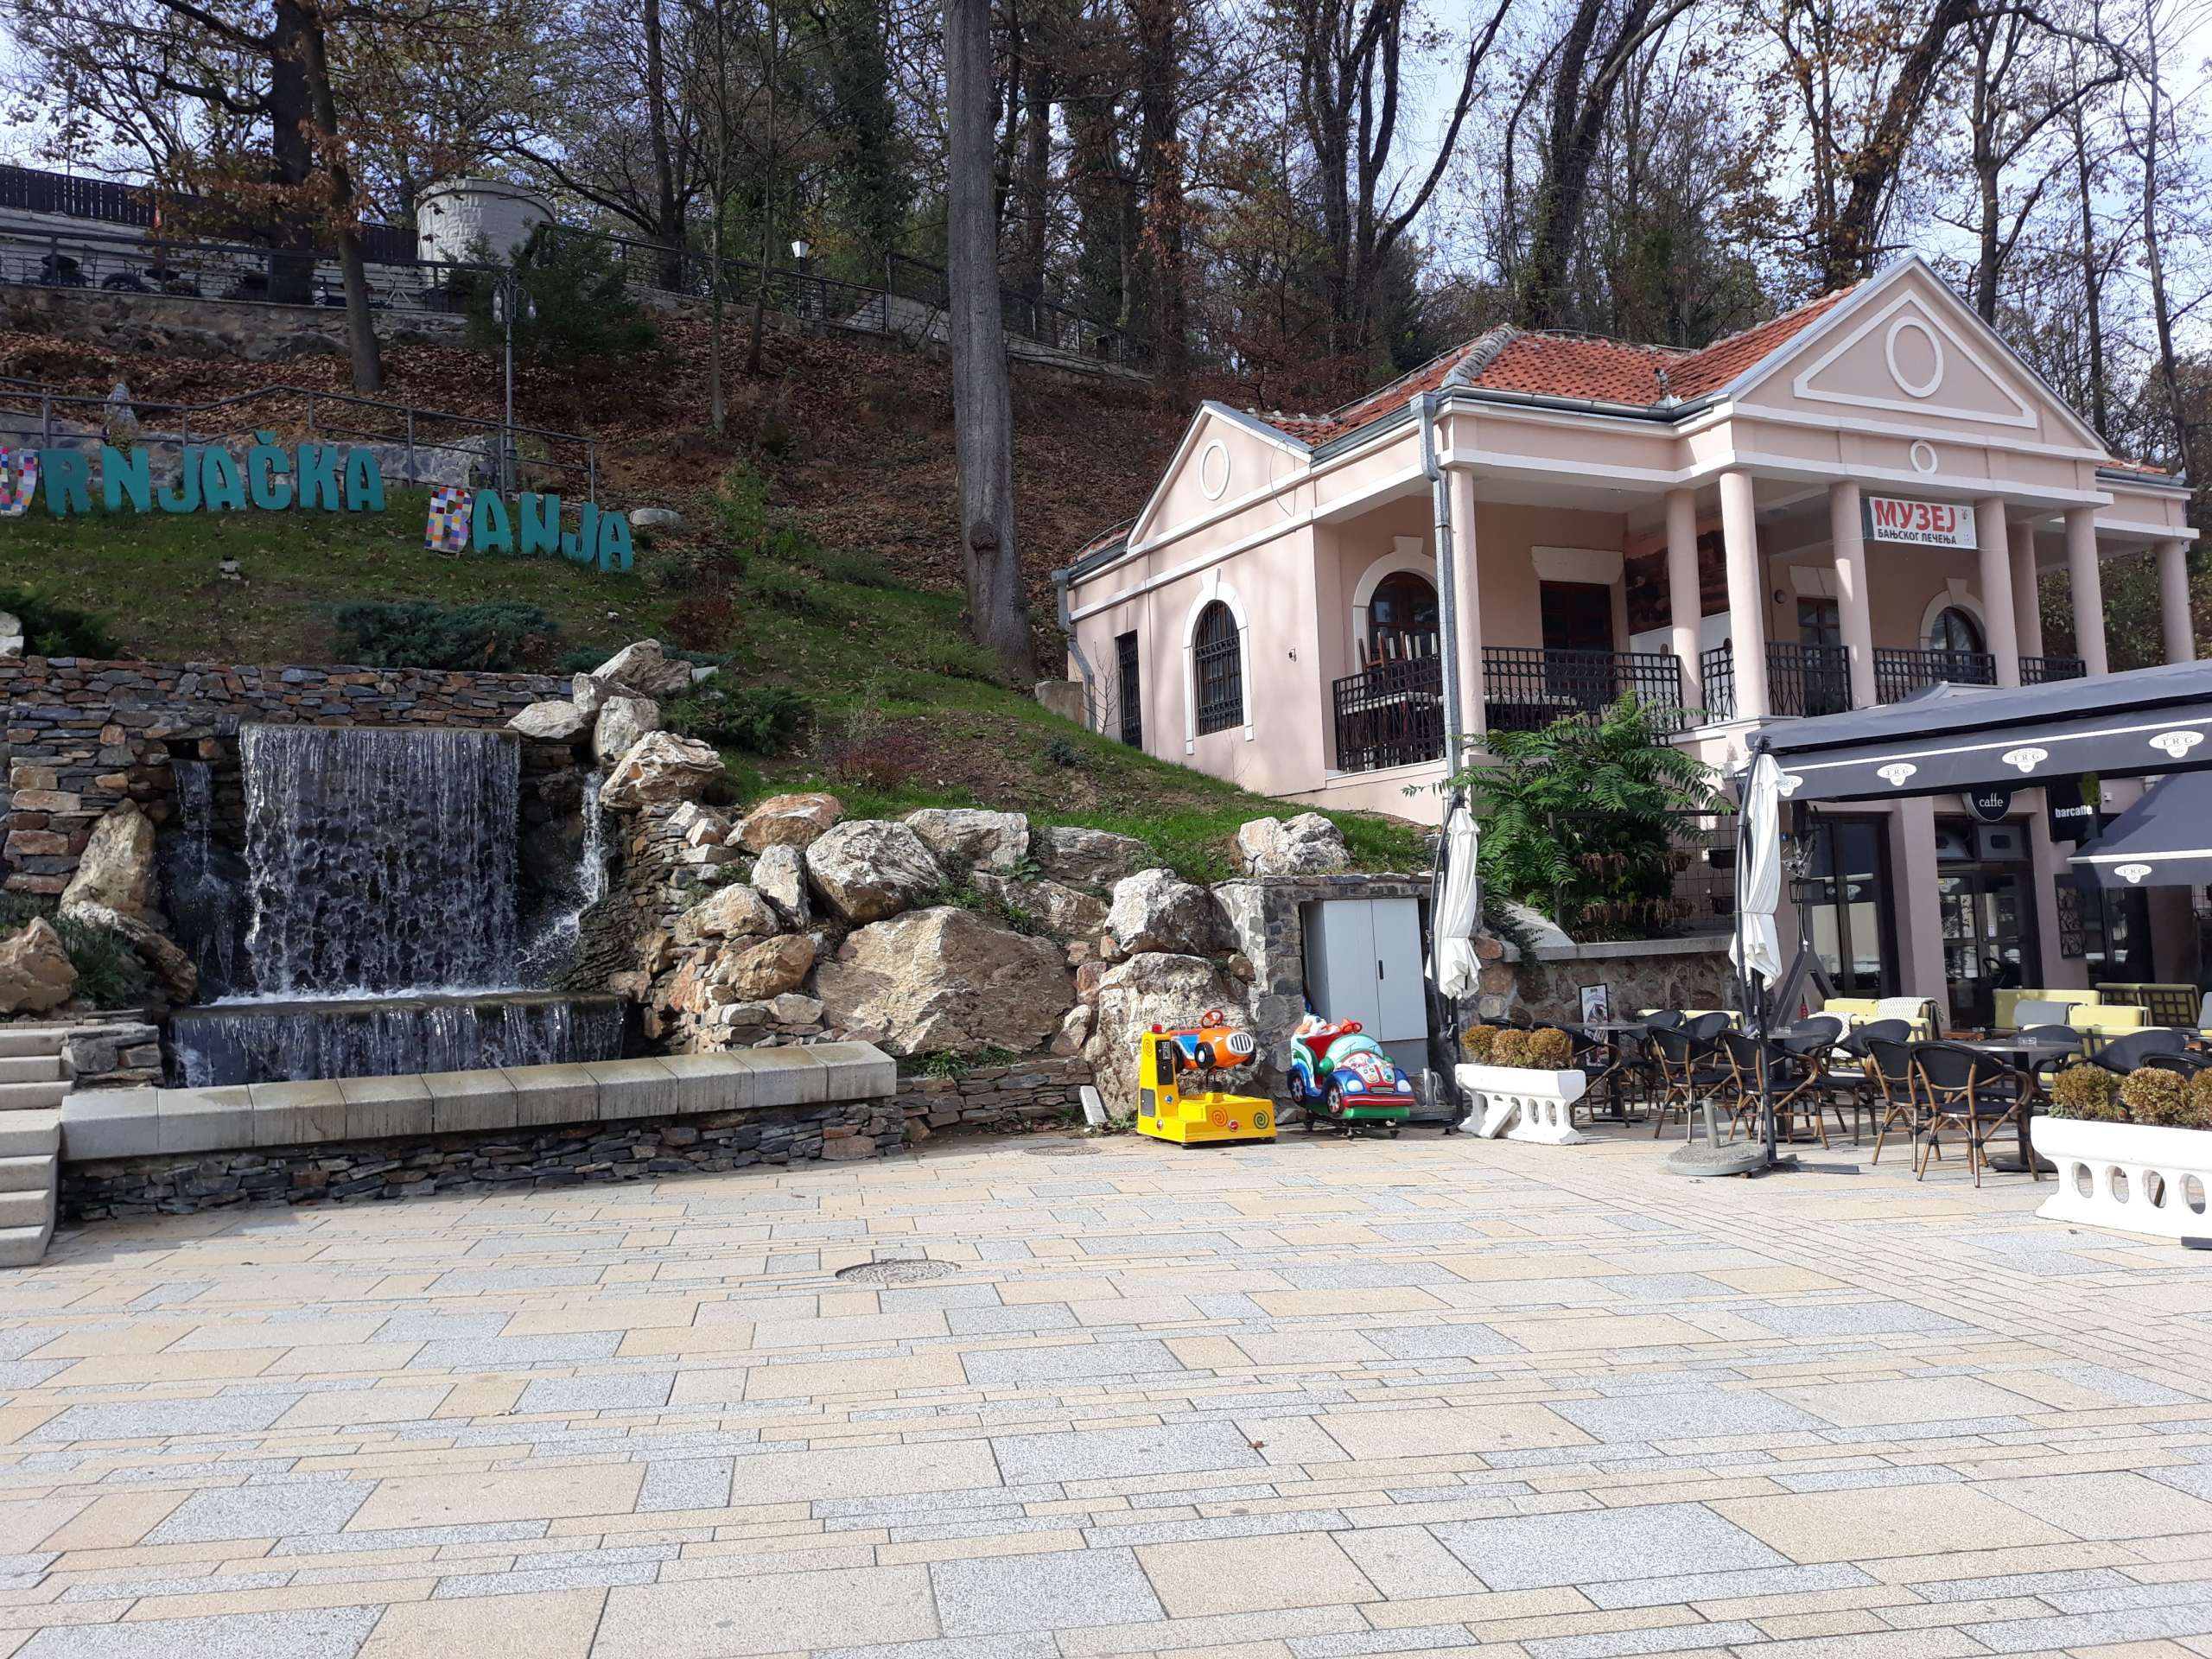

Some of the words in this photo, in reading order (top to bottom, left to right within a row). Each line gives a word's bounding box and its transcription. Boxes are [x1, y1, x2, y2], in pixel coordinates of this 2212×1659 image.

[424, 486, 634, 571] BANJA
[1874, 499, 1956, 533] МУЗЕЈ
[1878, 528, 1919, 542] БАЊСКОГ
[1922, 533, 1957, 545] ЛЕЧЕЊА
[1979, 792, 2004, 807] caffe
